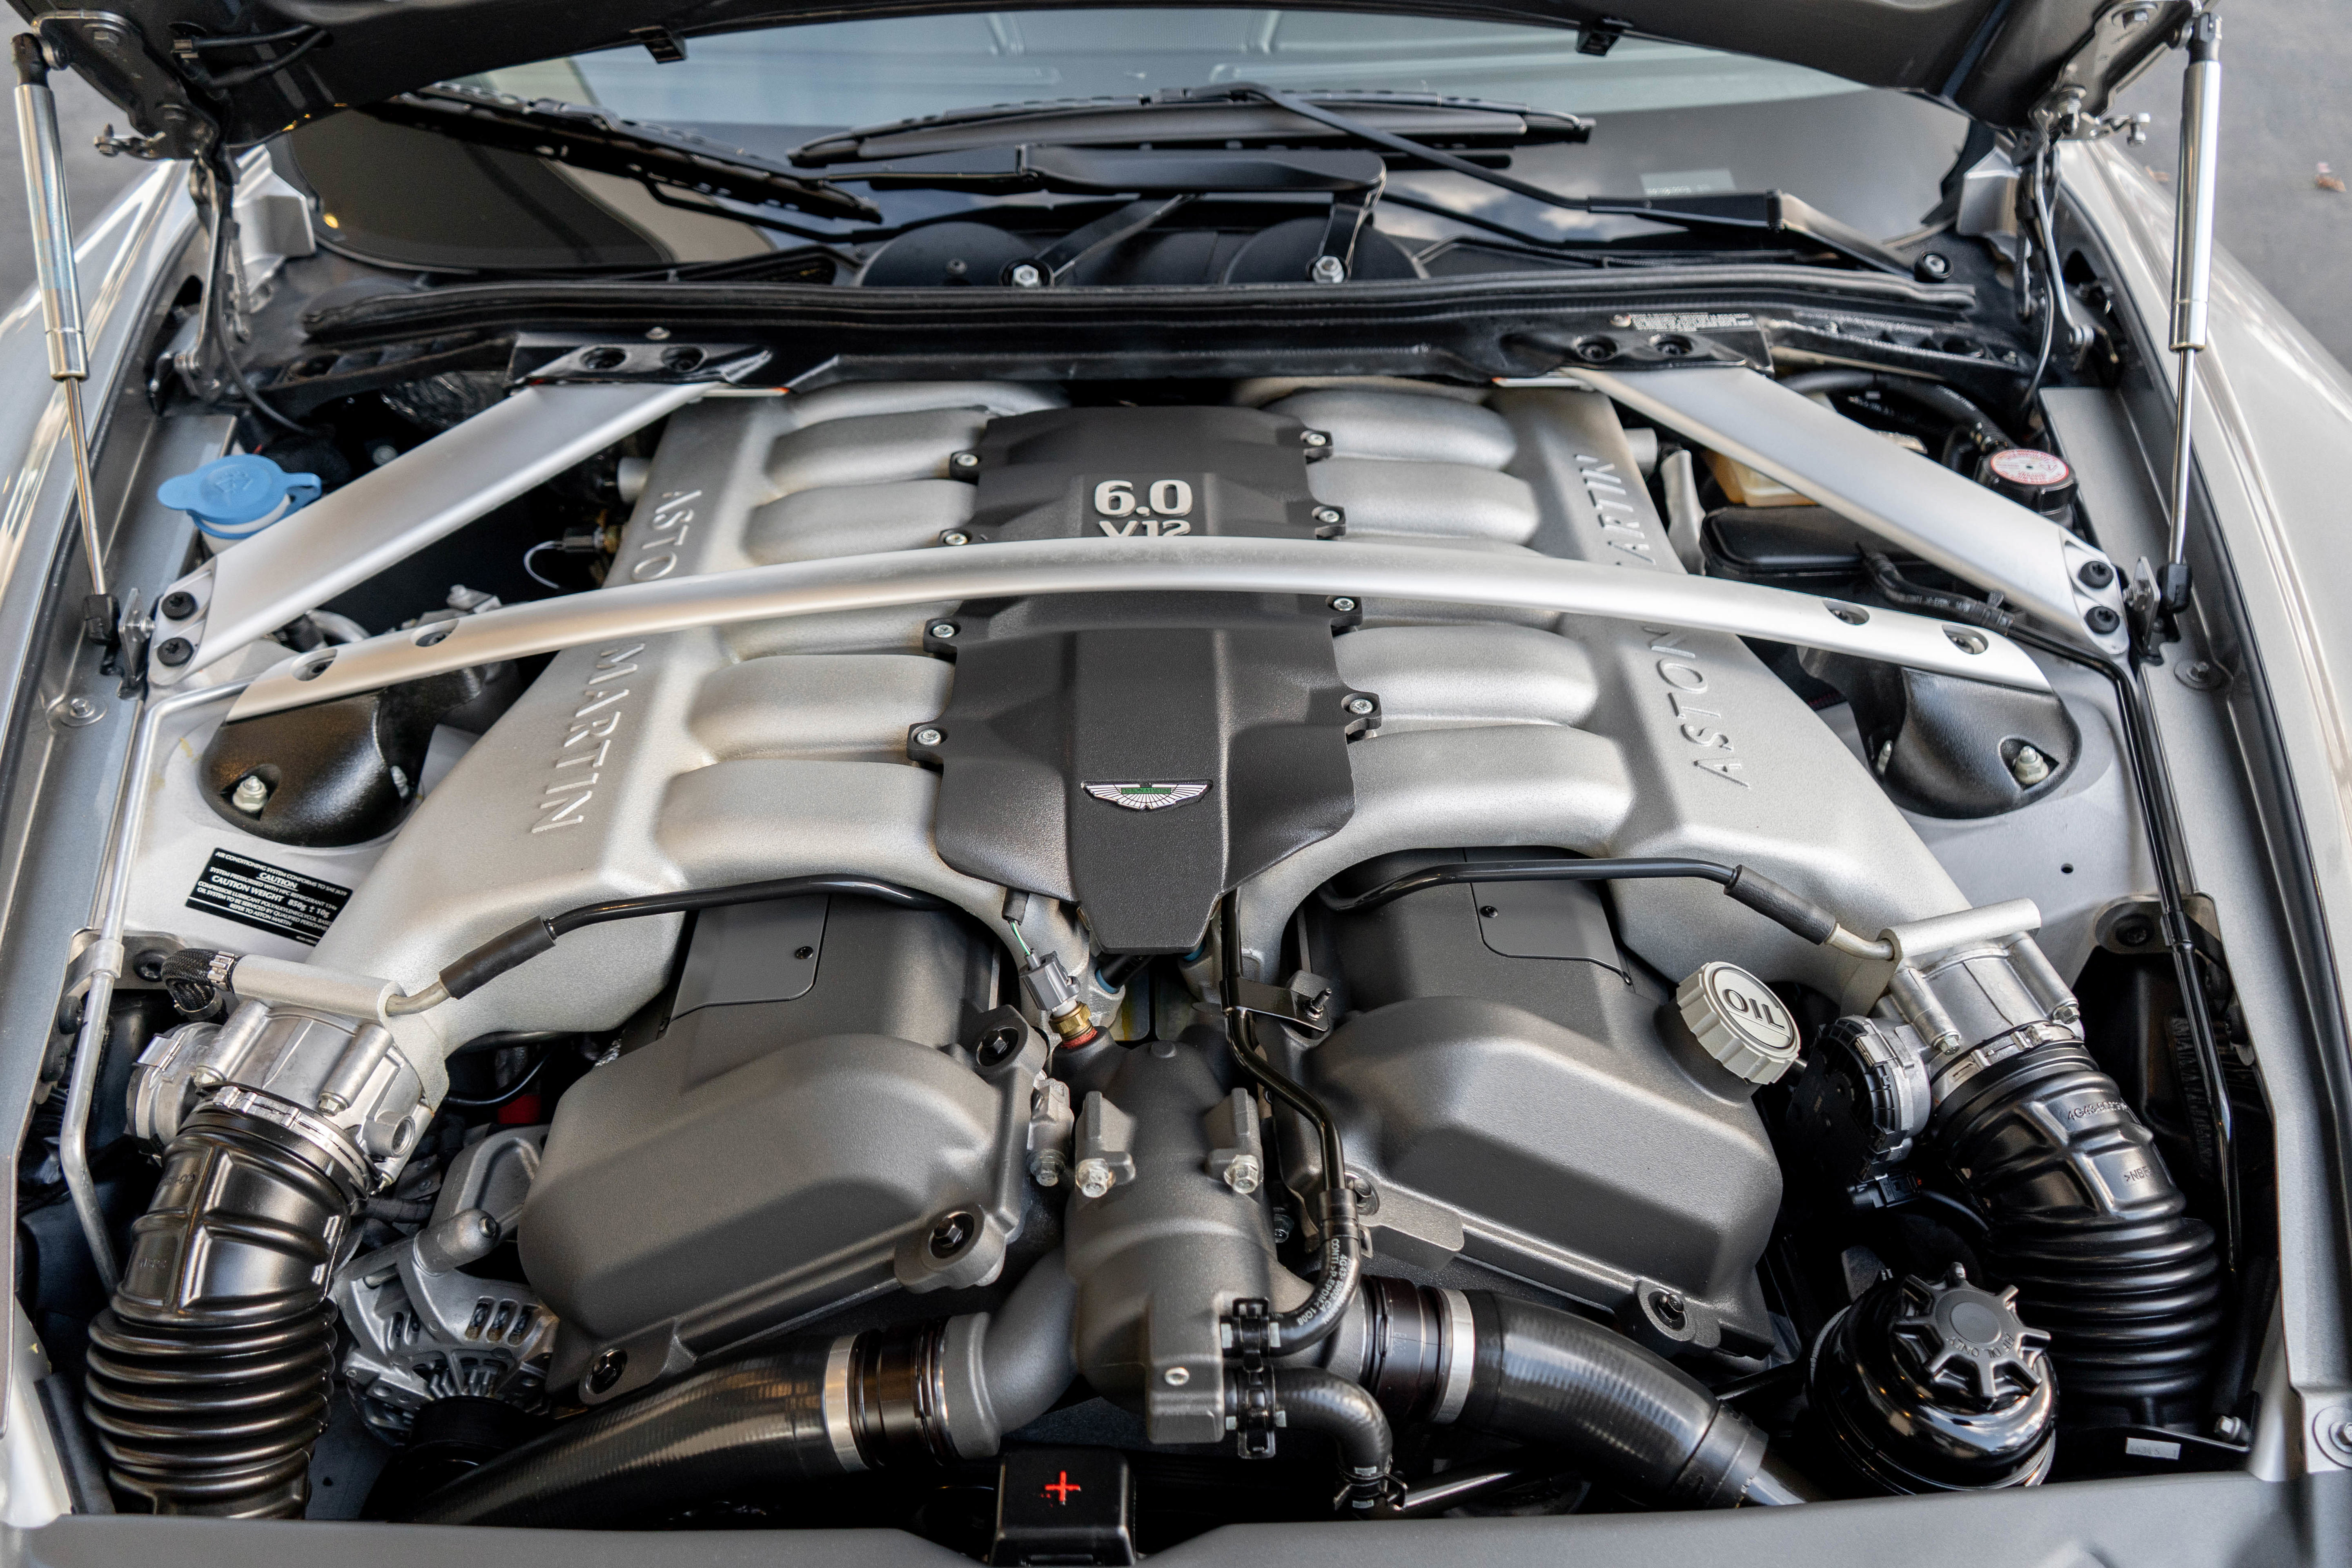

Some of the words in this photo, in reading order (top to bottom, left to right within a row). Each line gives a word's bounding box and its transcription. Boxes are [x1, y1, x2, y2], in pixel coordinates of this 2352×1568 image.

[1094, 479, 1193, 517] 6.0
[1575, 454, 1656, 566] ARTIN
[630, 490, 702, 581] ASTO
[1642, 626, 1751, 790] ASTON
[531, 643, 646, 834] MARTIN
[209, 866, 230, 877] SYSTEM
[229, 873, 264, 887] PRESSURISED
[263, 883, 279, 892] WITH
[290, 892, 325, 906] REFRIGERANT
[224, 854, 267, 871] CONDITIONING
[266, 867, 287, 877] SYSTEM
[285, 873, 318, 887] CONFORMS
[258, 871, 298, 889] CAUTION
[197, 880, 233, 895] COMPRESSOR
[232, 891, 261, 904] LUBRICANT
[206, 890, 227, 900] SYSTEM
[241, 900, 266, 912] SERVICED
[272, 910, 301, 923] QUALIFIED
[210, 874, 251, 892] CAUTION
[249, 887, 284, 902] WEIGHT
[286, 898, 308, 911] 850g
[314, 908, 332, 918] 10g
[228, 903, 245, 911] REFER
[252, 910, 272, 920] ASTON
[271, 916, 293, 926] MARTIN
[1722, 989, 1785, 1031] OIL
[1331, 1238, 1339, 1264] CONTI
[1946, 1336, 1979, 1358] ONLY
